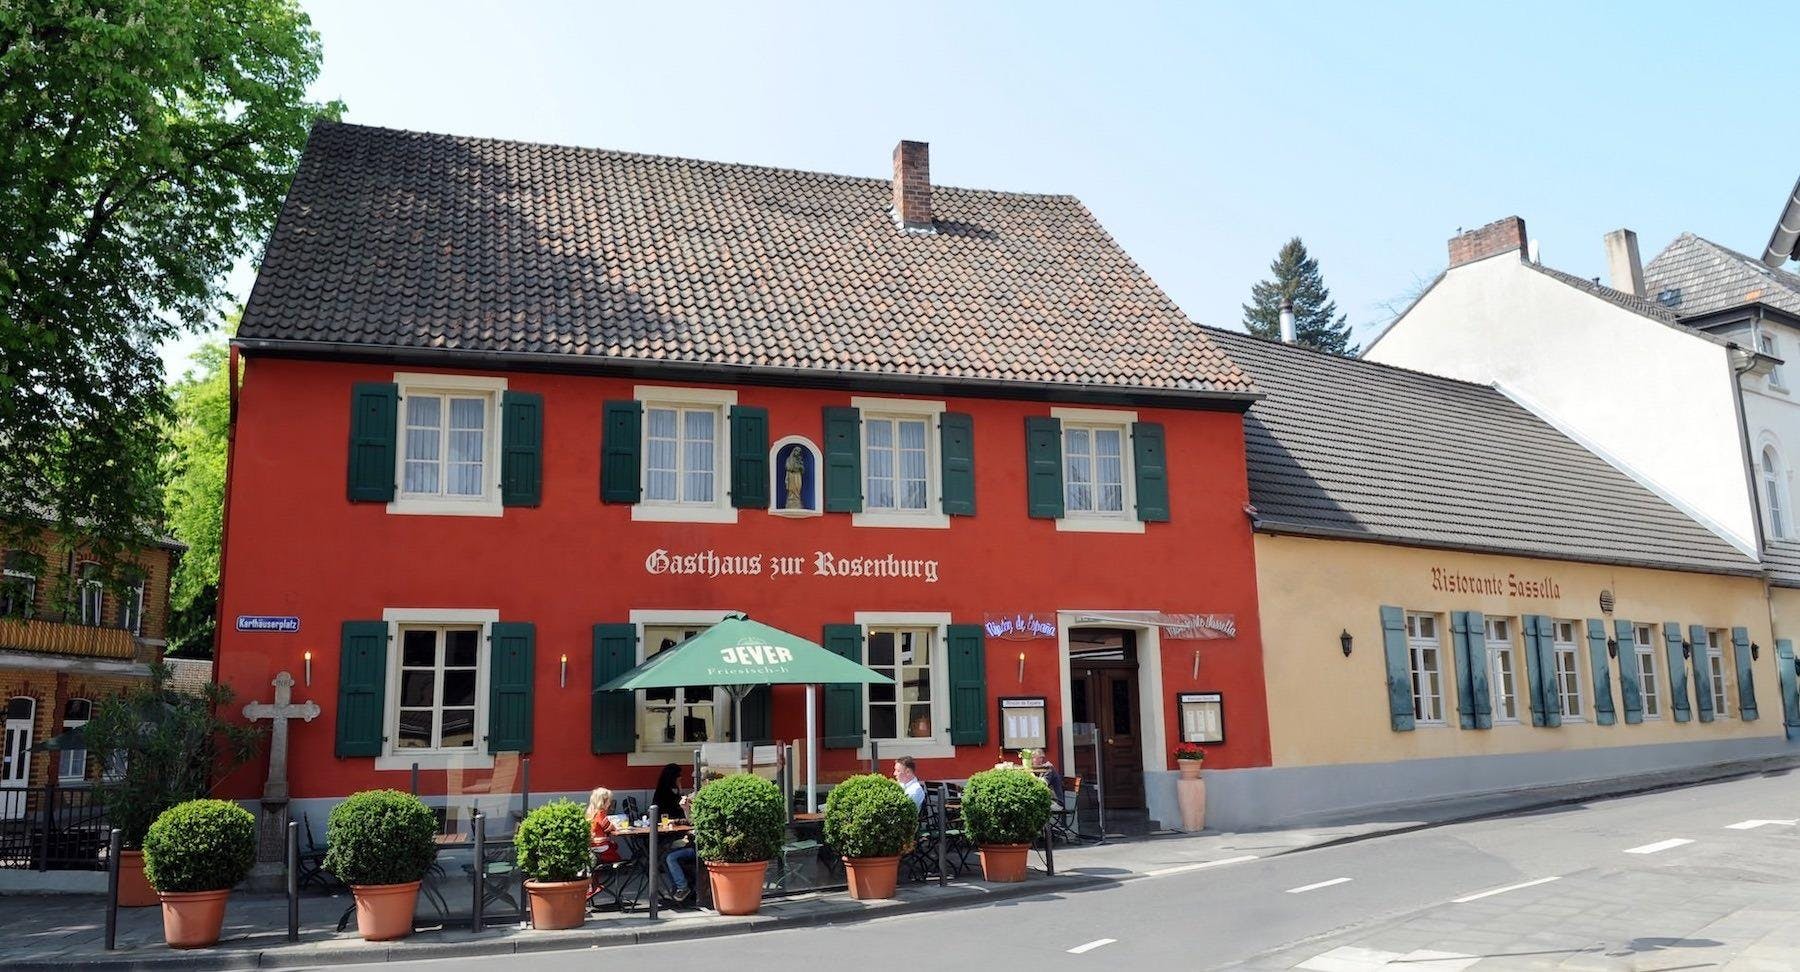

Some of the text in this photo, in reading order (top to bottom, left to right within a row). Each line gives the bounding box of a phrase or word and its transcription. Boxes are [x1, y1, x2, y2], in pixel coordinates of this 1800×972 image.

[645, 549, 939, 583] Gasthaus zur Rosenburg
[1431, 567, 1560, 599] Ristorante Sassella
[239, 618, 297, 631] Karthäuserplatz
[720, 645, 794, 666] JEVER
